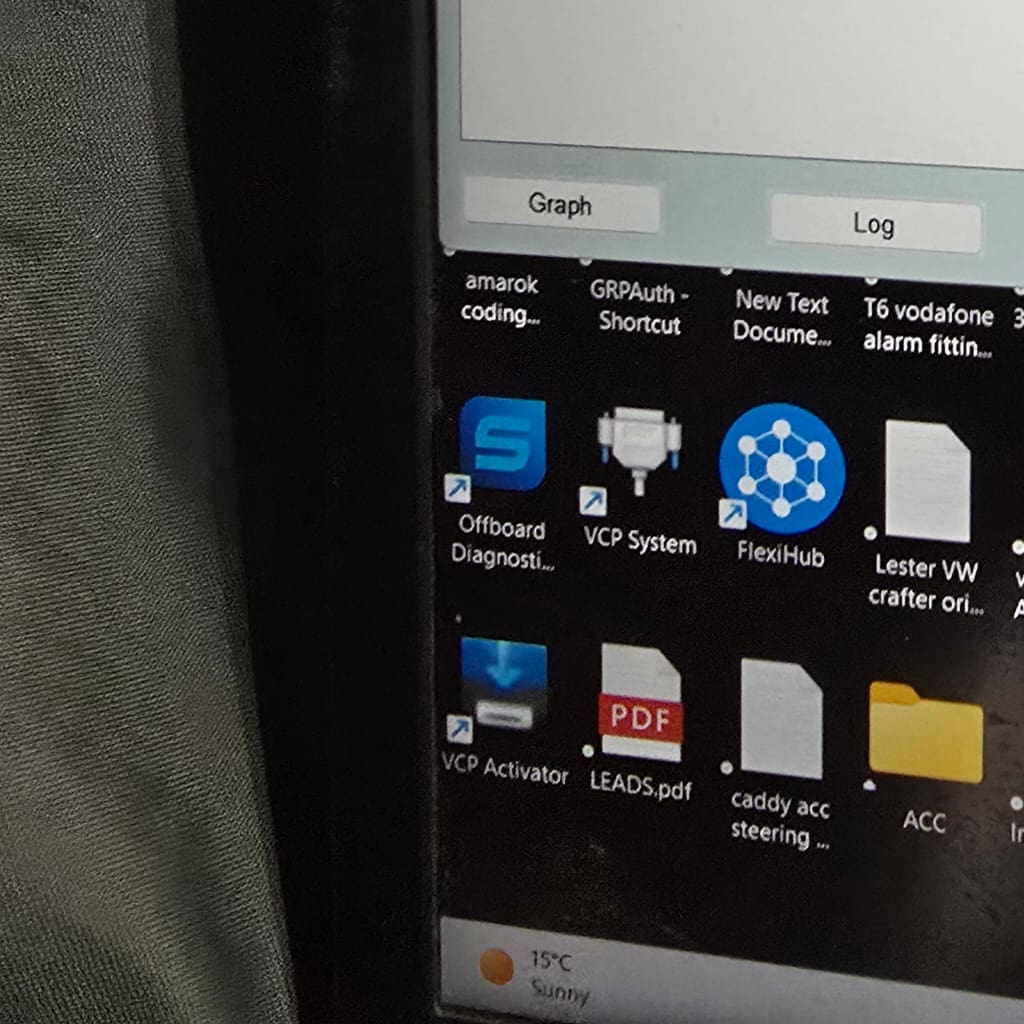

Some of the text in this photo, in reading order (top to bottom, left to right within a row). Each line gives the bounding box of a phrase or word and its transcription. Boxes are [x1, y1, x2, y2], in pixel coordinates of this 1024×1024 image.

[528, 192, 593, 218] Graph
[853, 211, 896, 241] Log
[465, 274, 539, 294] amarok
[590, 279, 676, 304] GRPAuth
[736, 289, 830, 316] New Text
[864, 298, 995, 327] T6 vodafone
[599, 311, 681, 336] Shortcut
[863, 329, 923, 354] alarm
[459, 515, 546, 541] Offboard
[584, 527, 697, 556] VCP System
[738, 542, 825, 568] FlexiHub
[876, 555, 979, 583] Lester VW
[868, 588, 937, 611] crafter
[610, 704, 670, 732] PDF
[441, 753, 569, 785] VCP Activator
[590, 770, 693, 802] LEADS.pdf
[731, 791, 831, 820] caddy acc
[731, 820, 811, 851] steering
[903, 810, 947, 834] ACC
[530, 950, 572, 973] 15°C
[530, 980, 590, 1008] Sunny
